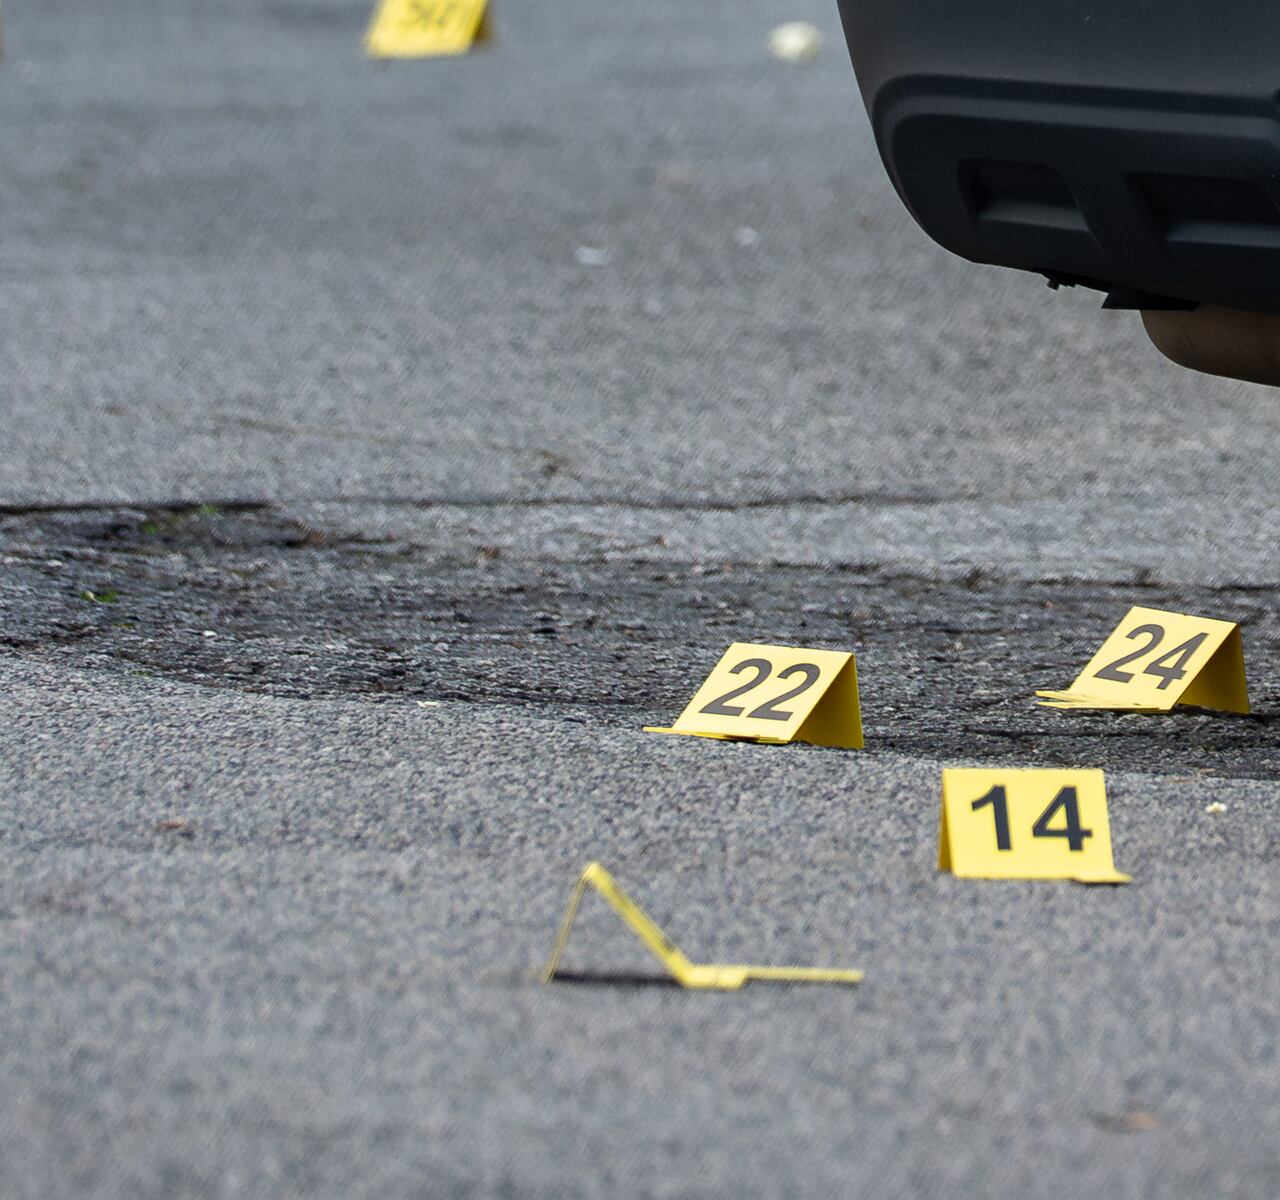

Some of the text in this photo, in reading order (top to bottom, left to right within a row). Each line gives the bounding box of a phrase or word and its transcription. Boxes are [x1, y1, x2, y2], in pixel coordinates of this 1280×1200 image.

[698, 658, 821, 722] 22
[1093, 623, 1209, 690] 24
[971, 784, 1093, 852] 14
